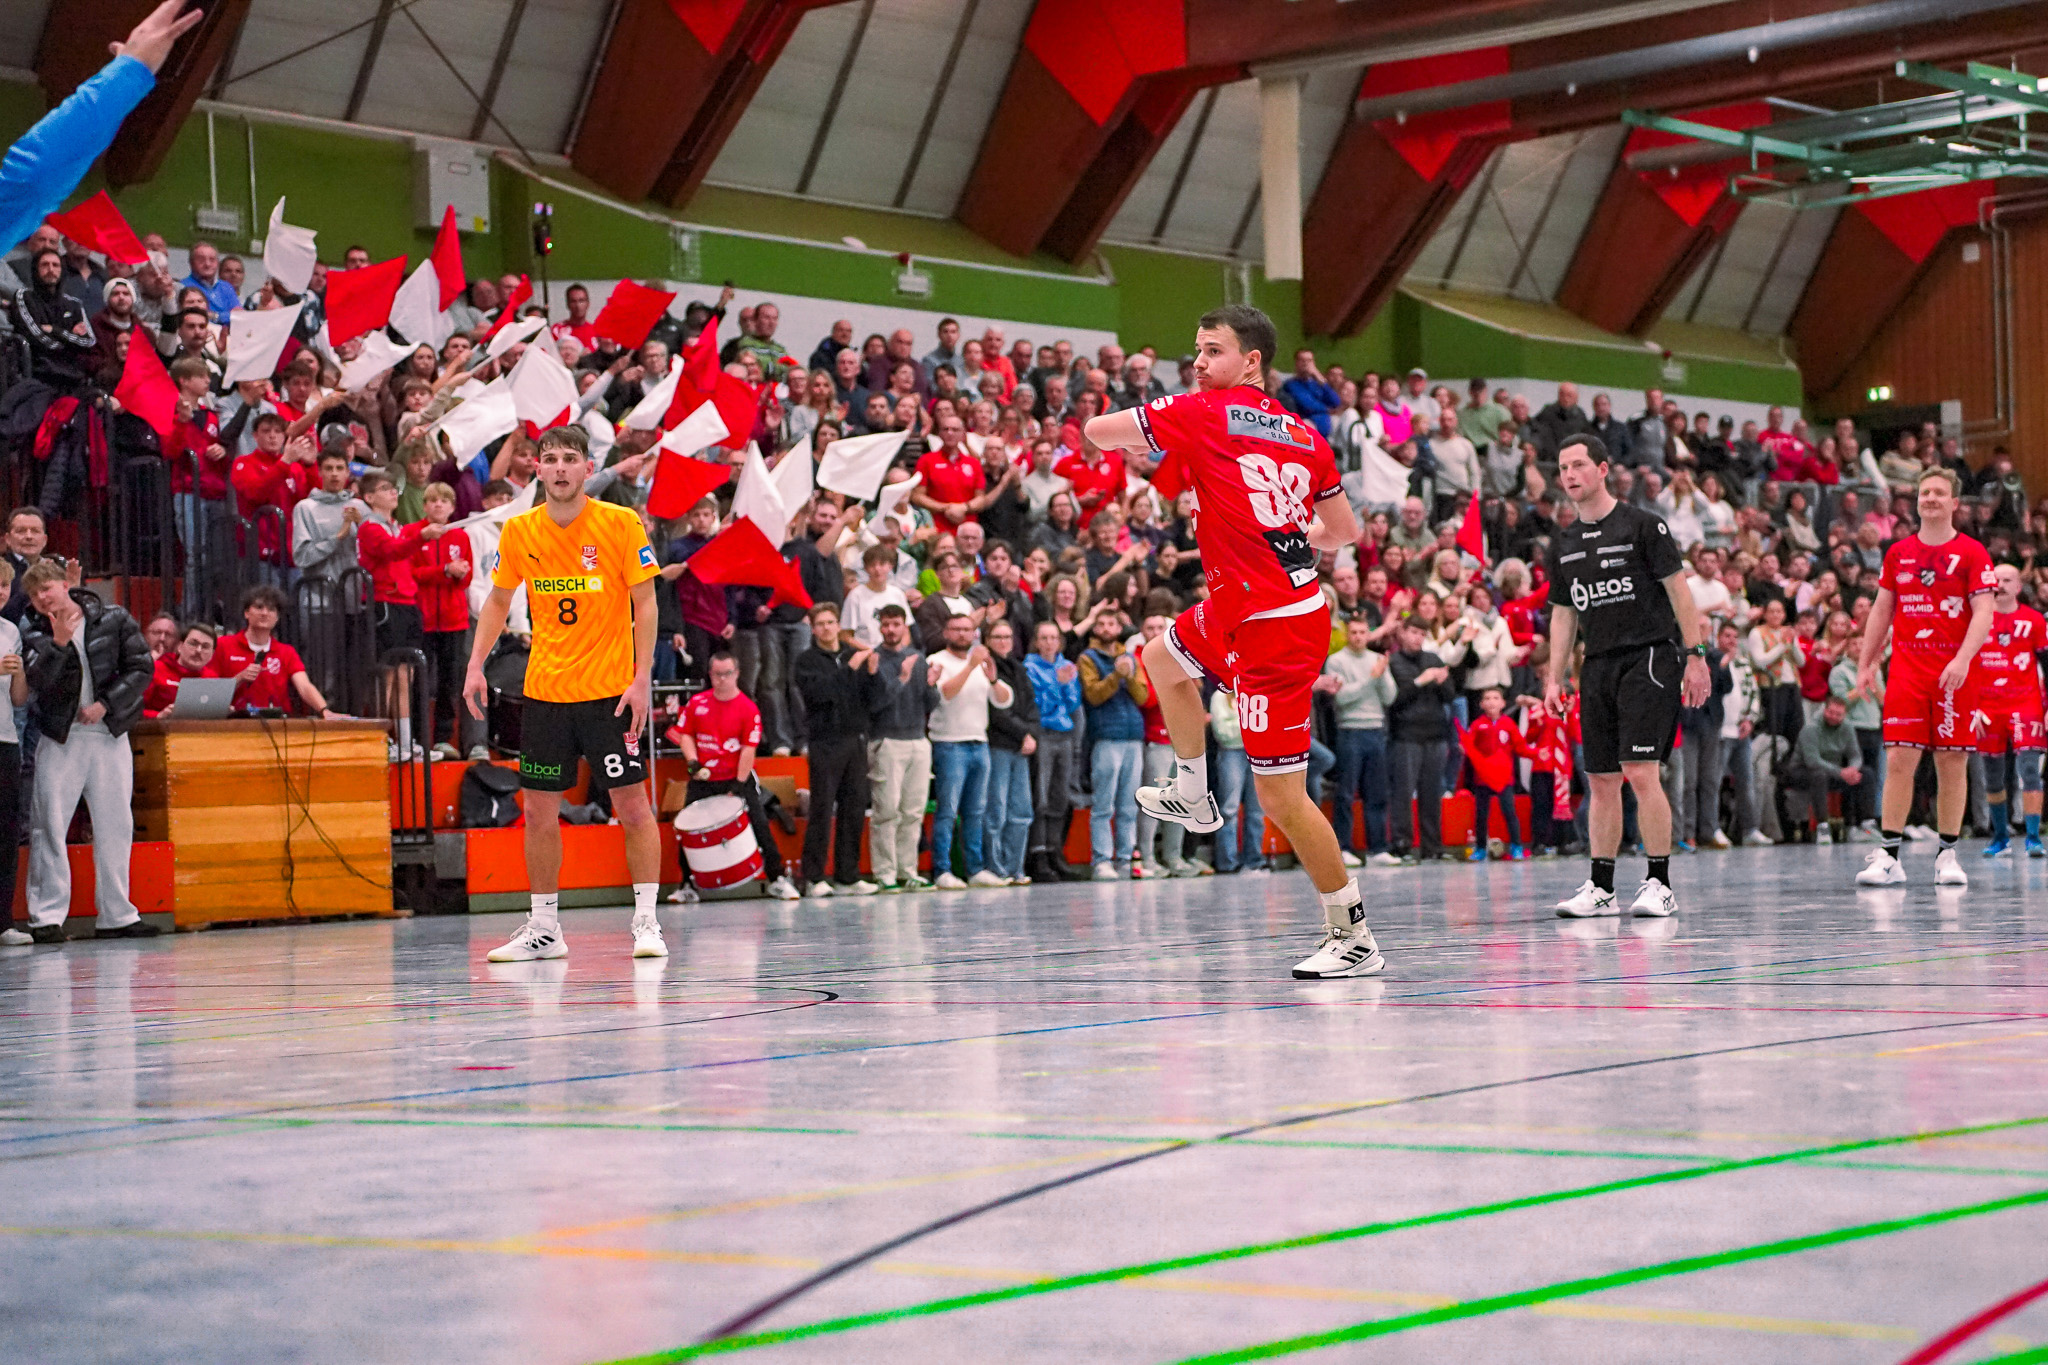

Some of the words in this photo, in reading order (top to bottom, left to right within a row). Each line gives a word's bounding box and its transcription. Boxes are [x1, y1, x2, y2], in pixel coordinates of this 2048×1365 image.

[1320, 485, 1341, 497] Kempa
[1946, 554, 1962, 575] 7
[1588, 576, 1634, 599] LEOS
[558, 598, 578, 625] 8
[2014, 620, 2033, 638] 77
[1184, 650, 1204, 671] Kempa
[1217, 682, 1234, 694] Kem
[1239, 692, 1269, 733] 98
[535, 762, 561, 775] bad
[603, 753, 625, 778] 8
[1278, 756, 1300, 764] Kempa
